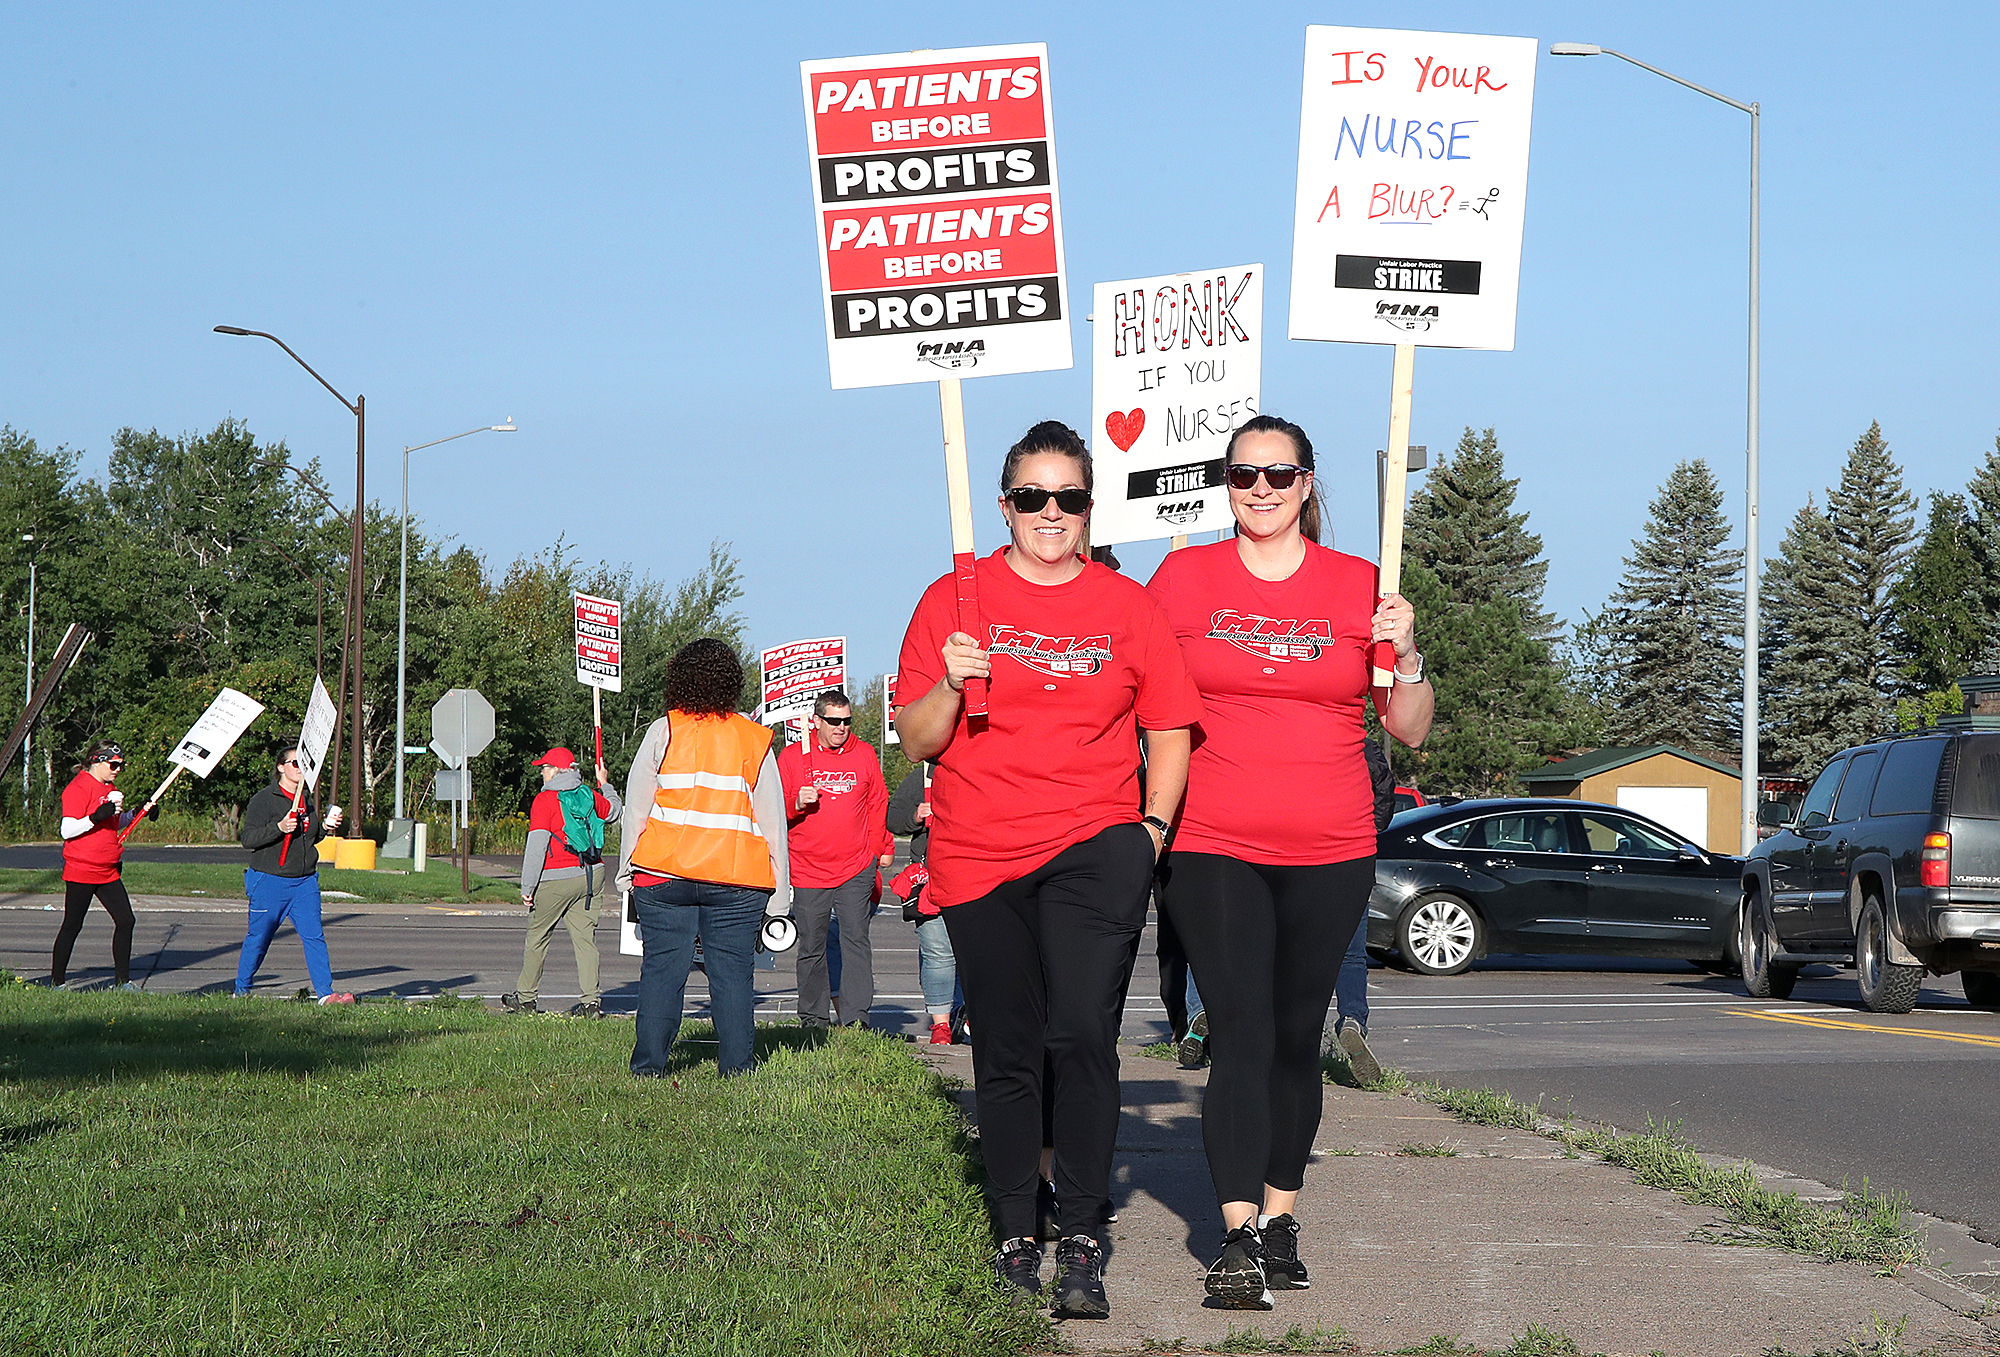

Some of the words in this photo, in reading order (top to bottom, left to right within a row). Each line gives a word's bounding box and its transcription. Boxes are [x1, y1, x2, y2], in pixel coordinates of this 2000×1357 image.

[1332, 51, 1386, 85] IS
[1414, 56, 1507, 94] YOUR
[816, 66, 1040, 114] PATIENTS
[871, 112, 991, 143] BEFORE
[1334, 113, 1479, 160] NURSE
[834, 148, 1036, 197] PROFITS
[1317, 186, 1341, 223] A
[829, 202, 1051, 251] PATIENTS
[884, 248, 1003, 279] BEFORE
[1418, 261, 1443, 269] Practice
[1374, 267, 1443, 291] STRIKE
[847, 283, 1047, 332] PROFITS
[1115, 272, 1252, 357] HONK
[1377, 303, 1439, 317] MNA
[919, 339, 985, 356] MNA
[1139, 366, 1166, 392] IF
[1184, 359, 1225, 384] YOU
[1156, 470, 1206, 495] STRIKE
[1158, 500, 1204, 515] MNA
[577, 599, 618, 617] PATIENTS
[585, 612, 608, 623] BEFORE
[578, 621, 617, 639] PROFITS
[1212, 613, 1332, 639] MNA
[578, 636, 619, 654] PATIENTS
[992, 628, 1111, 654] MNA
[1206, 631, 1251, 641] Minnesota
[1252, 634, 1283, 643] Nurses
[1283, 636, 1334, 646] Association
[586, 650, 609, 660] BEFORE
[765, 640, 842, 663] PATIENTS
[782, 651, 824, 665] BEFORE
[988, 645, 1033, 656] Minnesota
[1033, 650, 1063, 661] Nurses
[1064, 649, 1113, 661] Association
[580, 658, 617, 676] PROFITS
[769, 657, 839, 680] PROFITS
[765, 667, 843, 694] PATIENTS
[782, 680, 825, 695] BEFORE
[813, 772, 857, 783] MNA
[1954, 875, 1991, 883] YUKON
